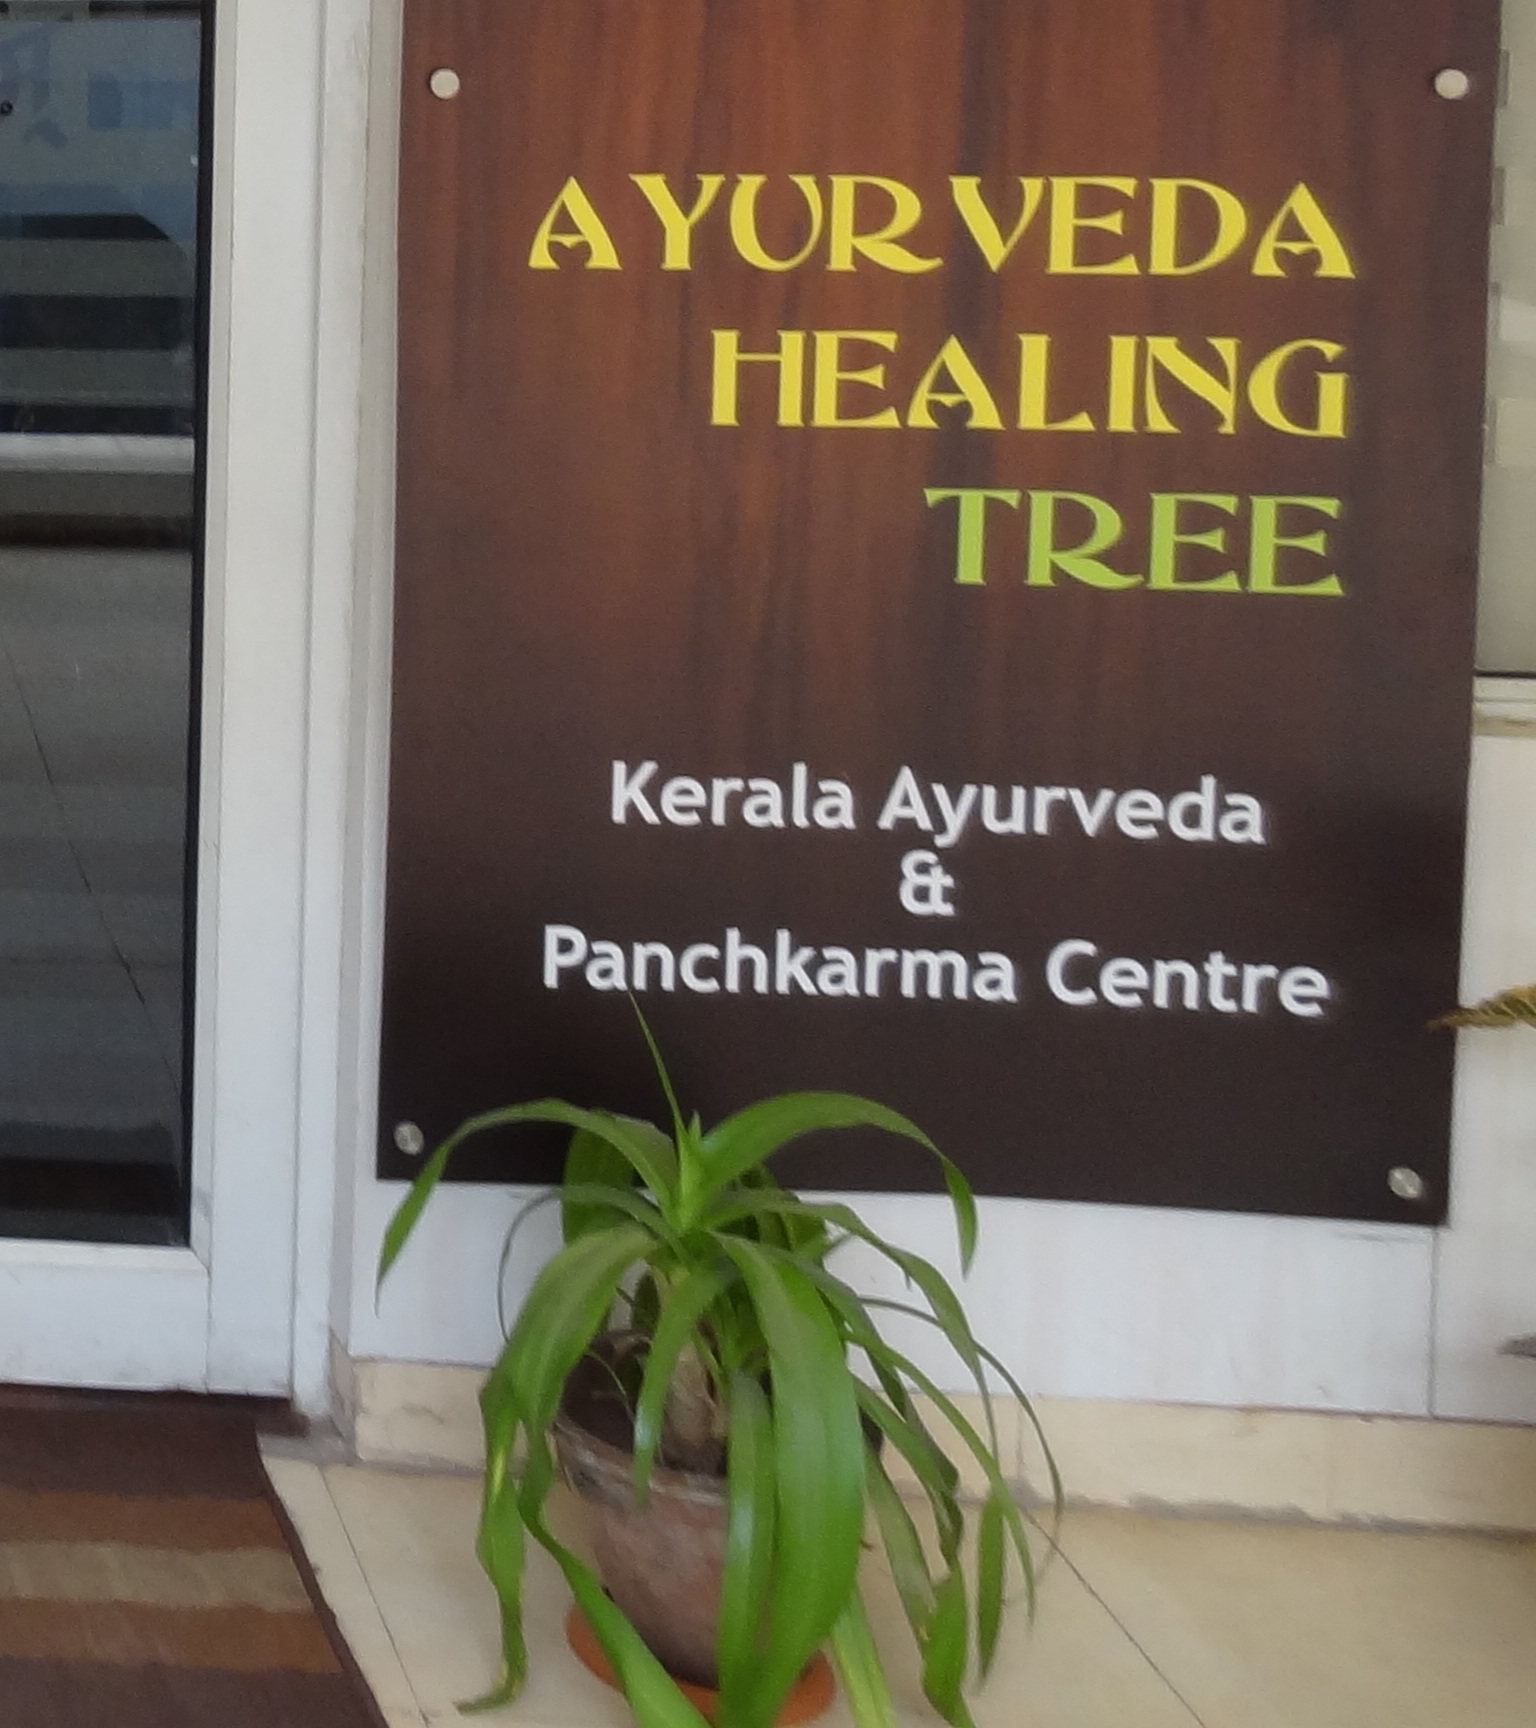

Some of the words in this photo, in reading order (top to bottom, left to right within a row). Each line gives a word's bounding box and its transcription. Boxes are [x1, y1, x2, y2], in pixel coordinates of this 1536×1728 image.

[528, 174, 1355, 278] AYURVEDA
[712, 330, 1348, 438] HEALING
[924, 488, 1342, 595] TREE
[612, 761, 856, 830] Kerala
[878, 766, 1265, 848] Ayurveda
[900, 850, 954, 916] &
[544, 924, 1017, 1003] Panchkarma
[1047, 940, 1330, 1017] Centre
